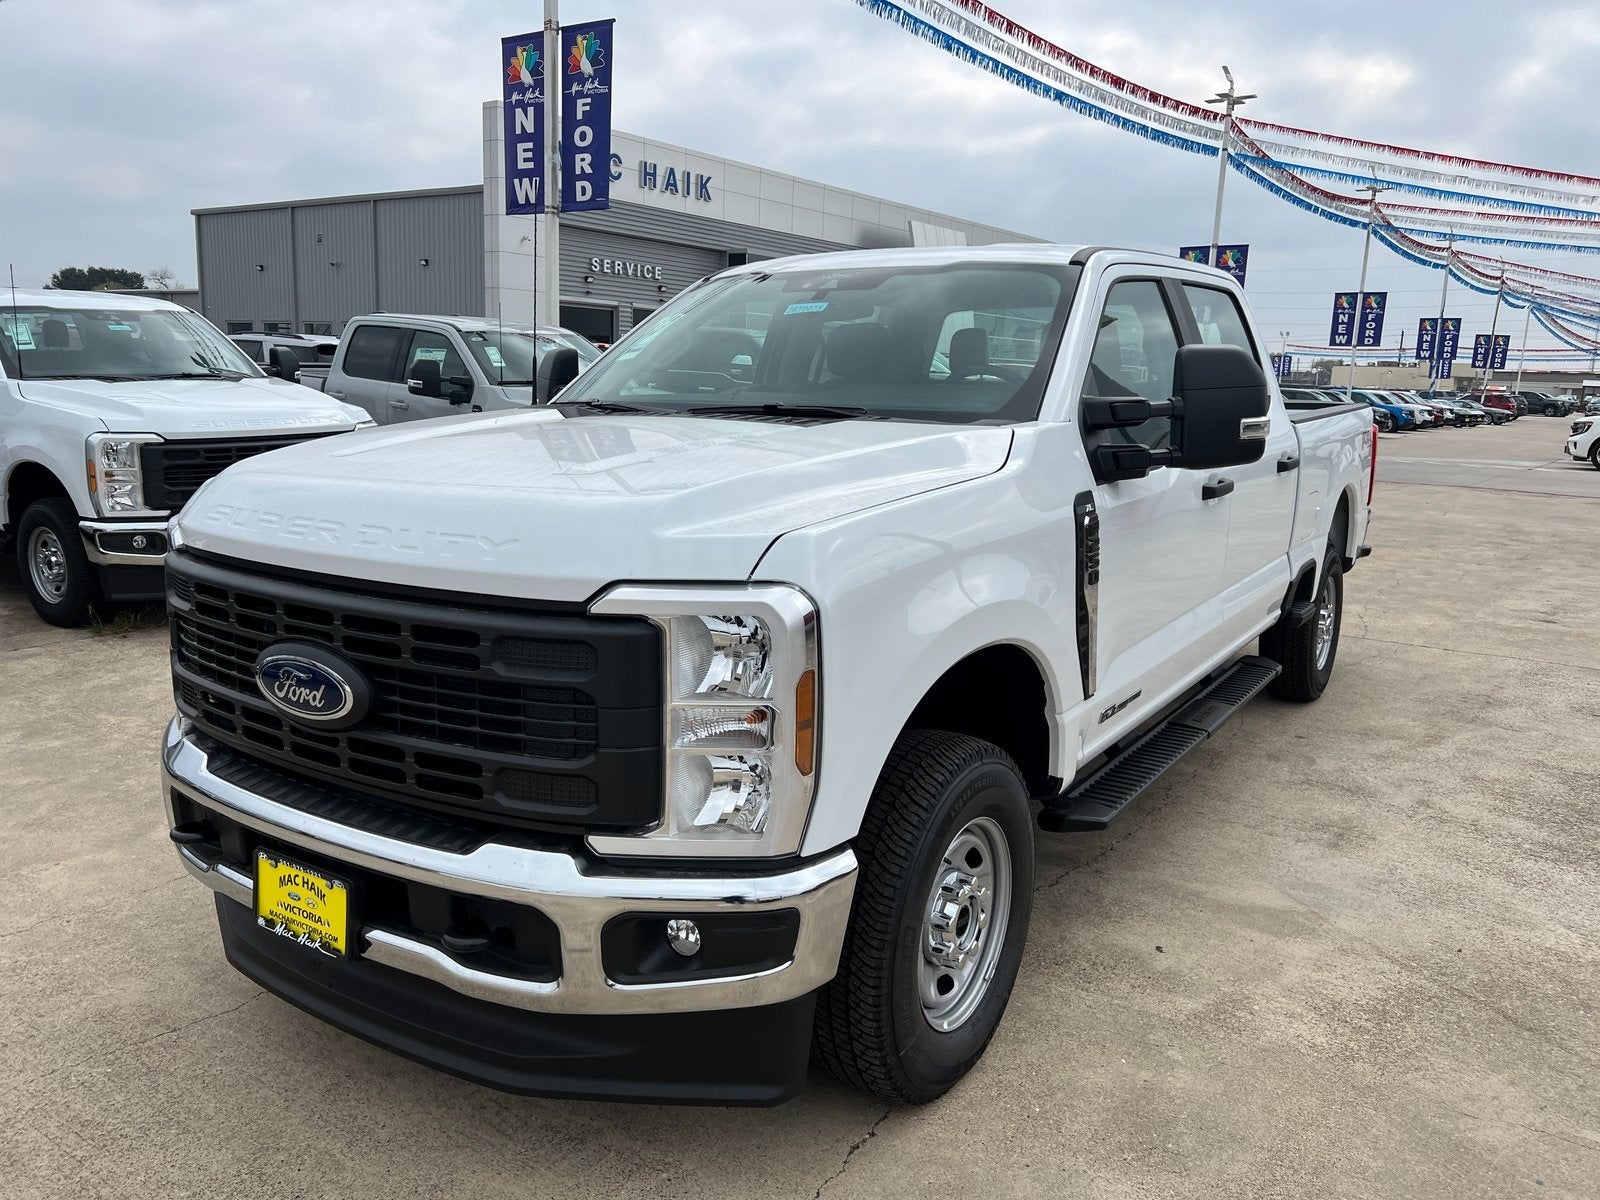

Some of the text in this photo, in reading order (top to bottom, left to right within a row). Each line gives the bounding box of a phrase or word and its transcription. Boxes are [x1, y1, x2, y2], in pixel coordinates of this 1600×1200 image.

[513, 107, 540, 204] NEW
[573, 98, 593, 202] FORD
[640, 160, 712, 202] HAIK
[591, 257, 663, 280] SERVICE
[1335, 314, 1349, 344] NEW
[1364, 314, 1376, 345] FORD
[1420, 334, 1431, 358] NEW
[1443, 334, 1453, 359] FORD
[1475, 348, 1485, 367] NEW
[1494, 348, 1503, 368] FORD
[206, 504, 518, 561] SUPER DUTY
[274, 666, 325, 707] Ford
[279, 874, 326, 906] MAC HAIK
[269, 909, 338, 944] MACHAIKVICTORIA.COM
[283, 902, 323, 926] VICTORIA
[273, 922, 297, 940] Mac
